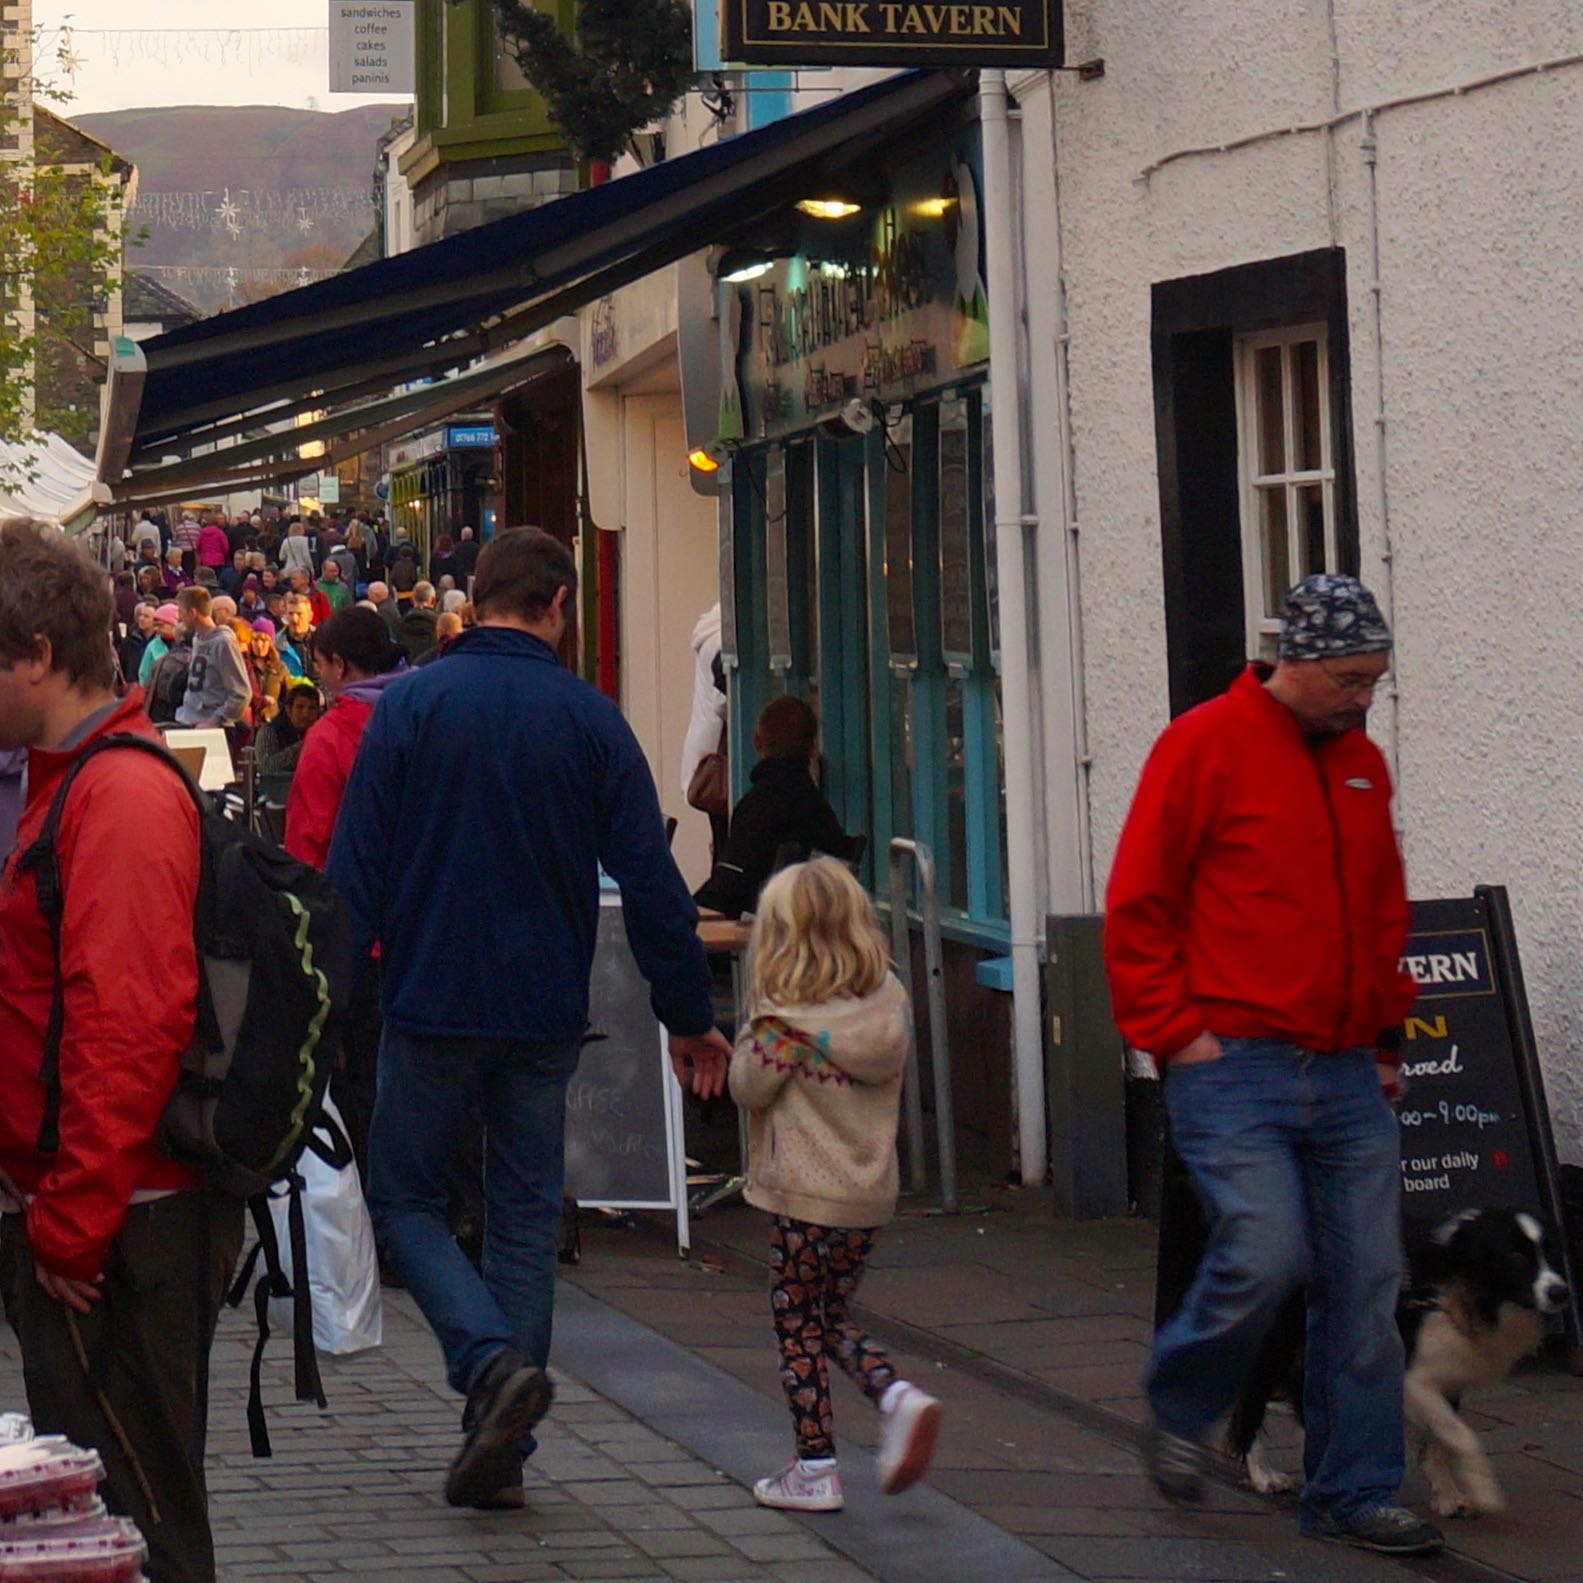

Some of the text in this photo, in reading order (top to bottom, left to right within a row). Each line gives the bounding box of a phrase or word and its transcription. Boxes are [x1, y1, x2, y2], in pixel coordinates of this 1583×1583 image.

[341, 7, 401, 18] sandwiches
[767, 0, 1023, 36] BANK TAVERN
[354, 23, 388, 35] coffee
[356, 40, 386, 51] cakes
[354, 56, 388, 68] salads
[351, 72, 390, 85] paninis
[1411, 1157, 1438, 1171] our
[1441, 1151, 1480, 1170] daily
[1403, 1173, 1450, 1193] board
